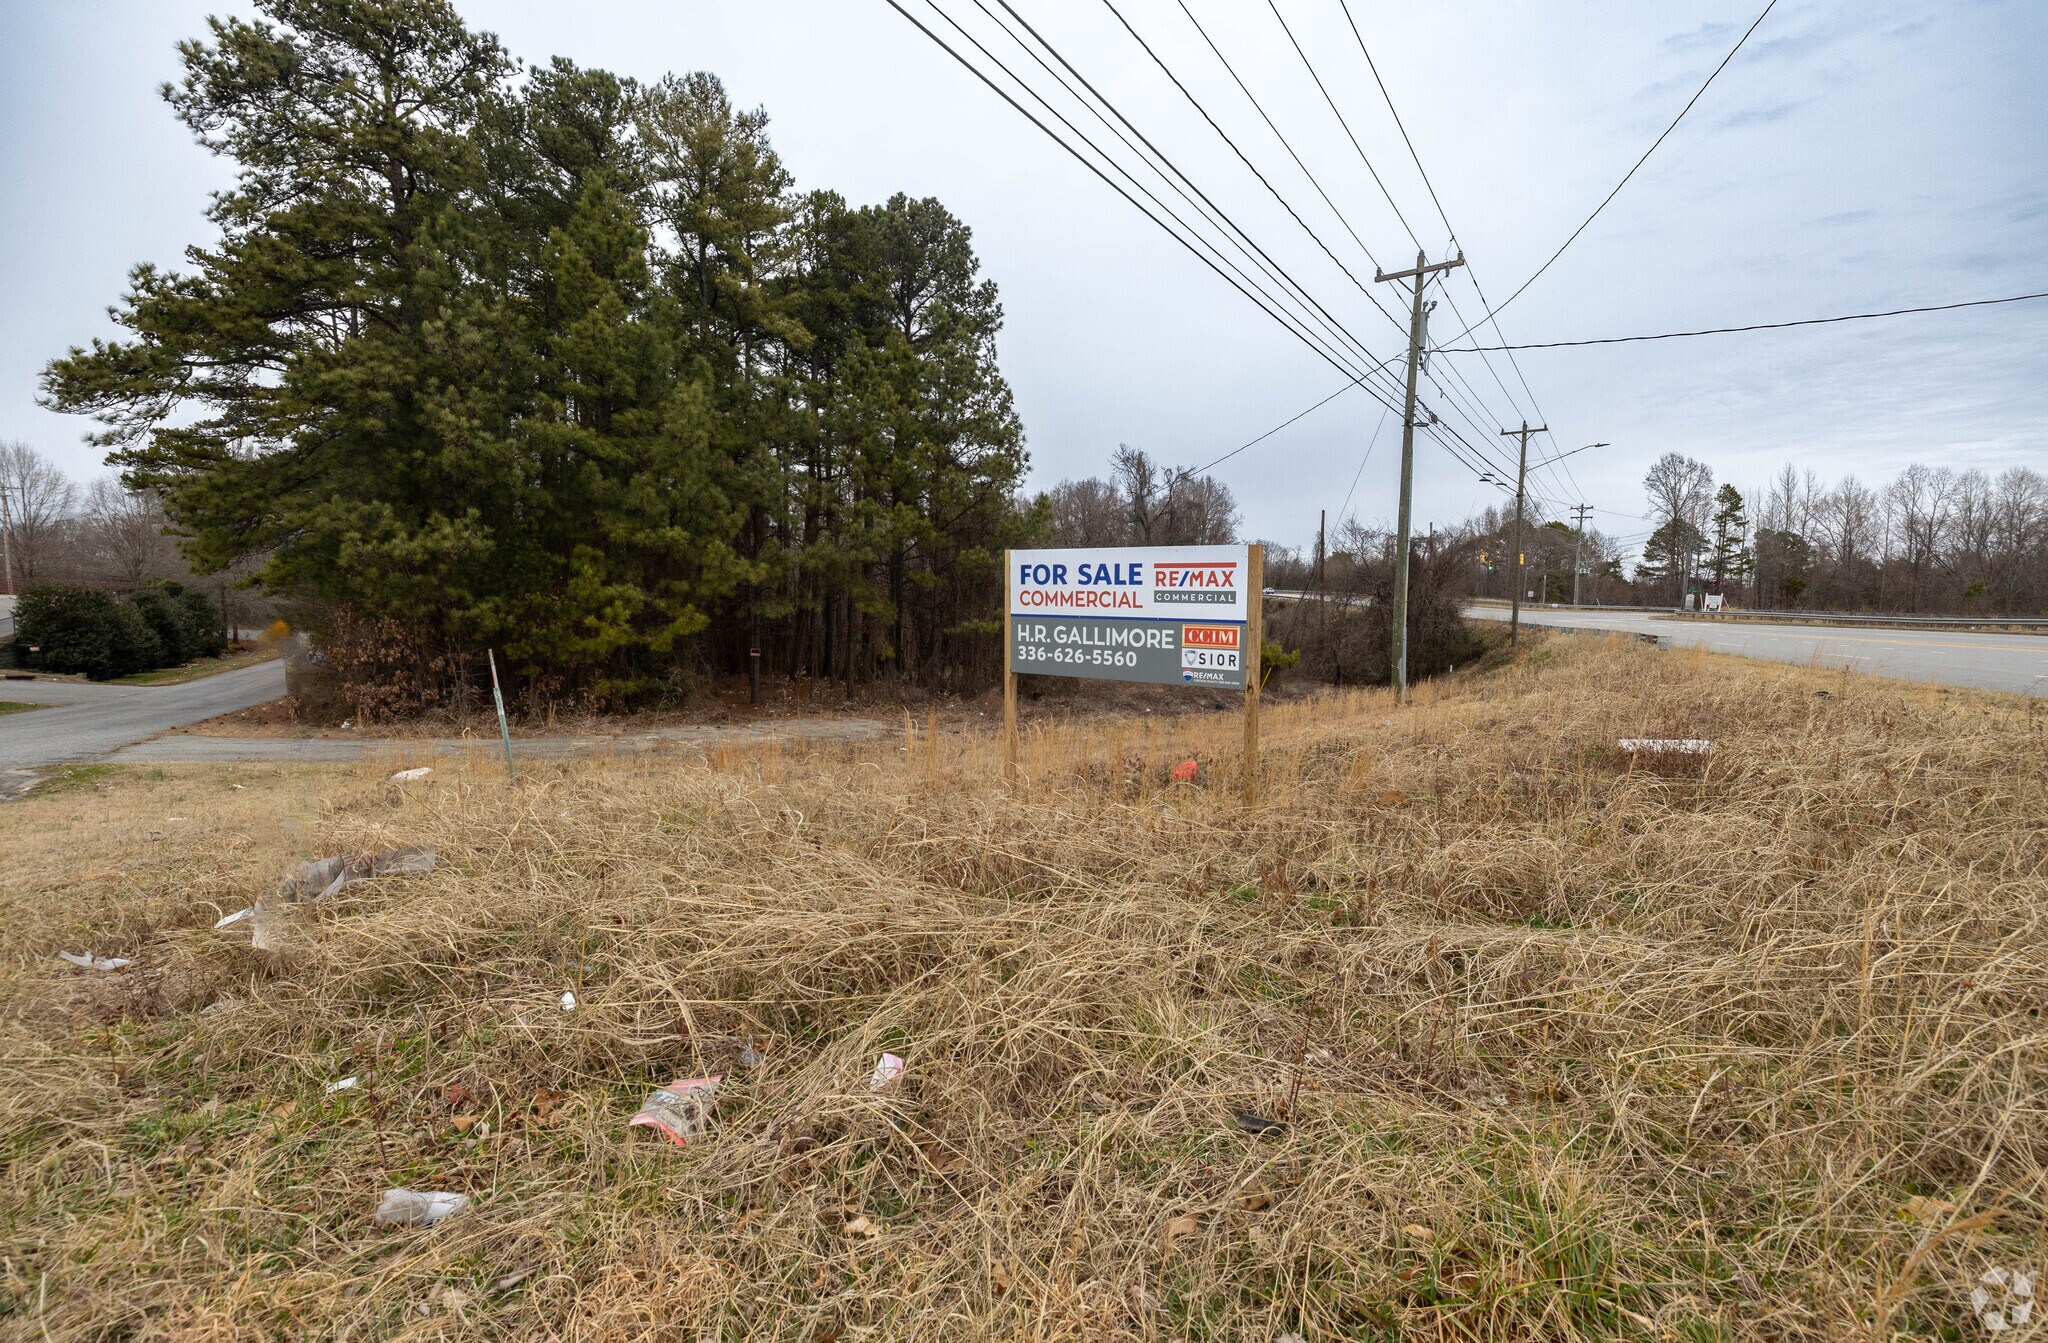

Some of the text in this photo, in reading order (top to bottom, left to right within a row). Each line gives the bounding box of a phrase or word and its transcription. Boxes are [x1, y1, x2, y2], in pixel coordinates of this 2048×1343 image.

[1020, 563, 1143, 585] FOR SALE
[1155, 570, 1234, 587] RE/MAX
[1019, 590, 1143, 609] COMMERCIAL
[1156, 593, 1233, 602] COMMERCIAL
[1017, 624, 1174, 649] H.R. GALLIMORE
[1188, 629, 1233, 644] CCIM
[1018, 645, 1137, 667] 336-626-5560
[1199, 652, 1237, 667] SIOR
[1193, 671, 1224, 680] RE/MAX
